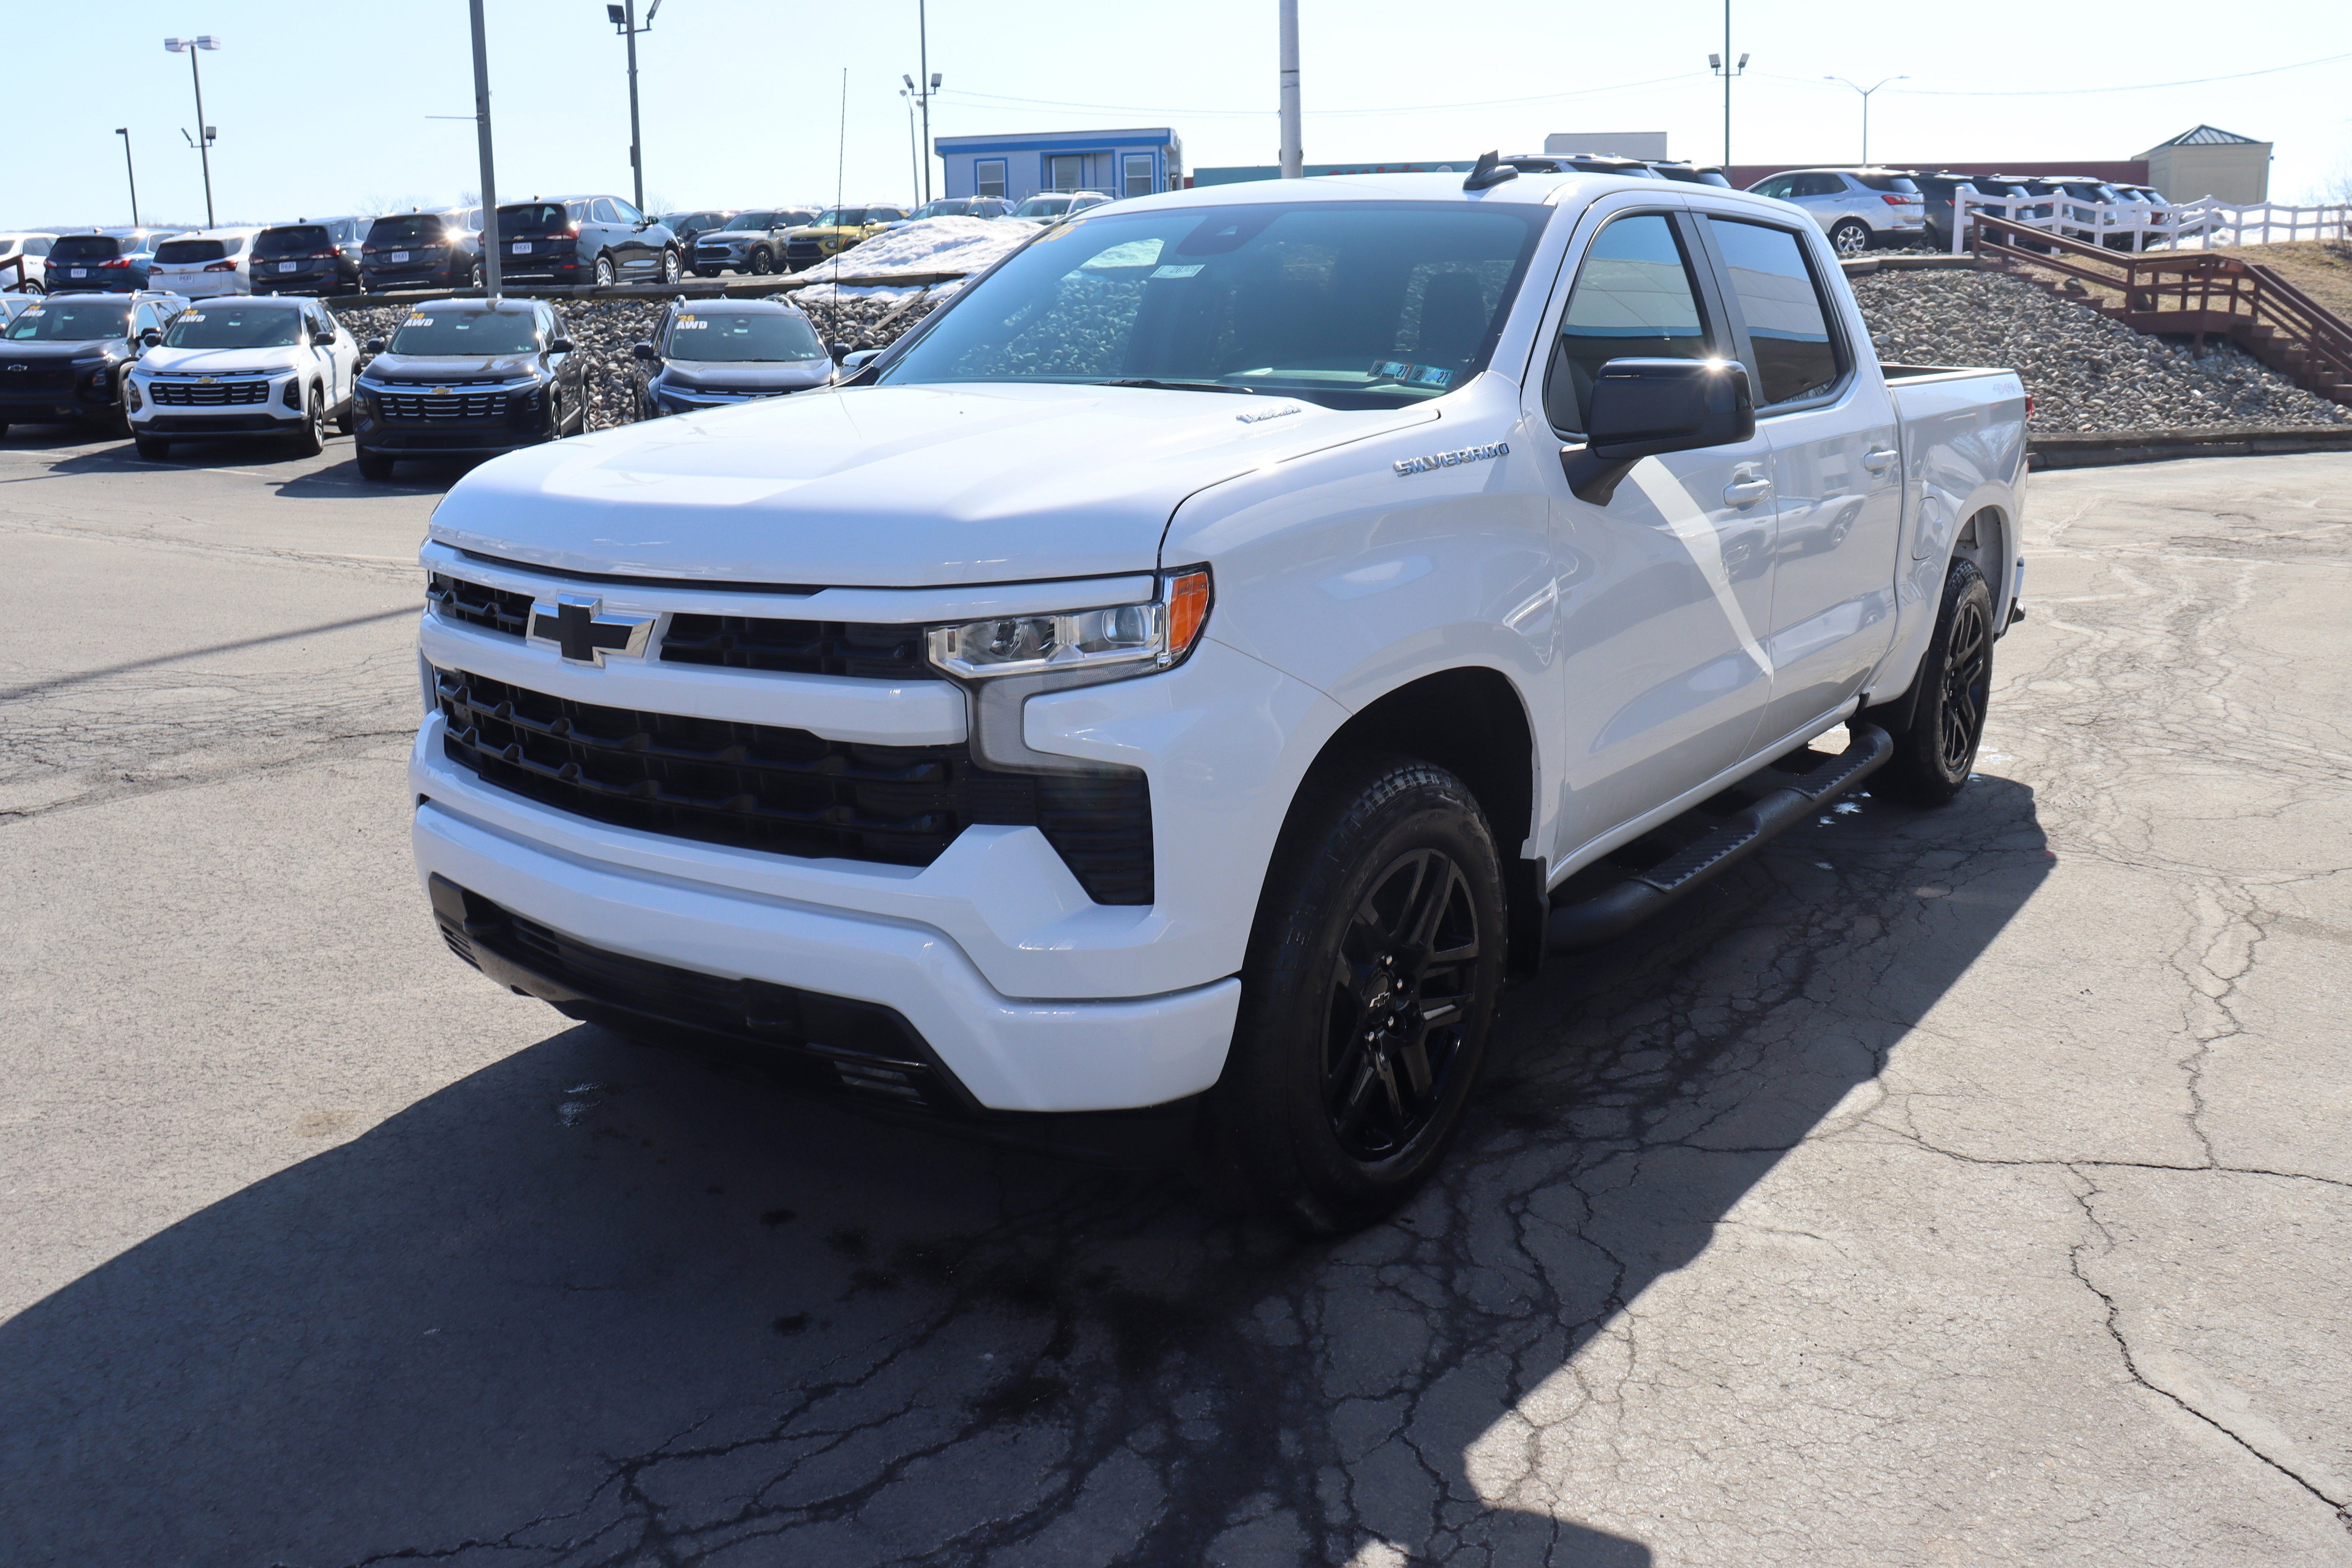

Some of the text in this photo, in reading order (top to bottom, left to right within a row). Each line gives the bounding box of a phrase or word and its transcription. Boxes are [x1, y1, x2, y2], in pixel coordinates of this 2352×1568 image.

[177, 314, 206, 323] AWD
[403, 318, 434, 327] AWD
[676, 321, 708, 330] AWD
[1373, 364, 1409, 379] 2 27
[1414, 370, 1449, 384] 2 27
[1393, 441, 1510, 477] SILVERADO
